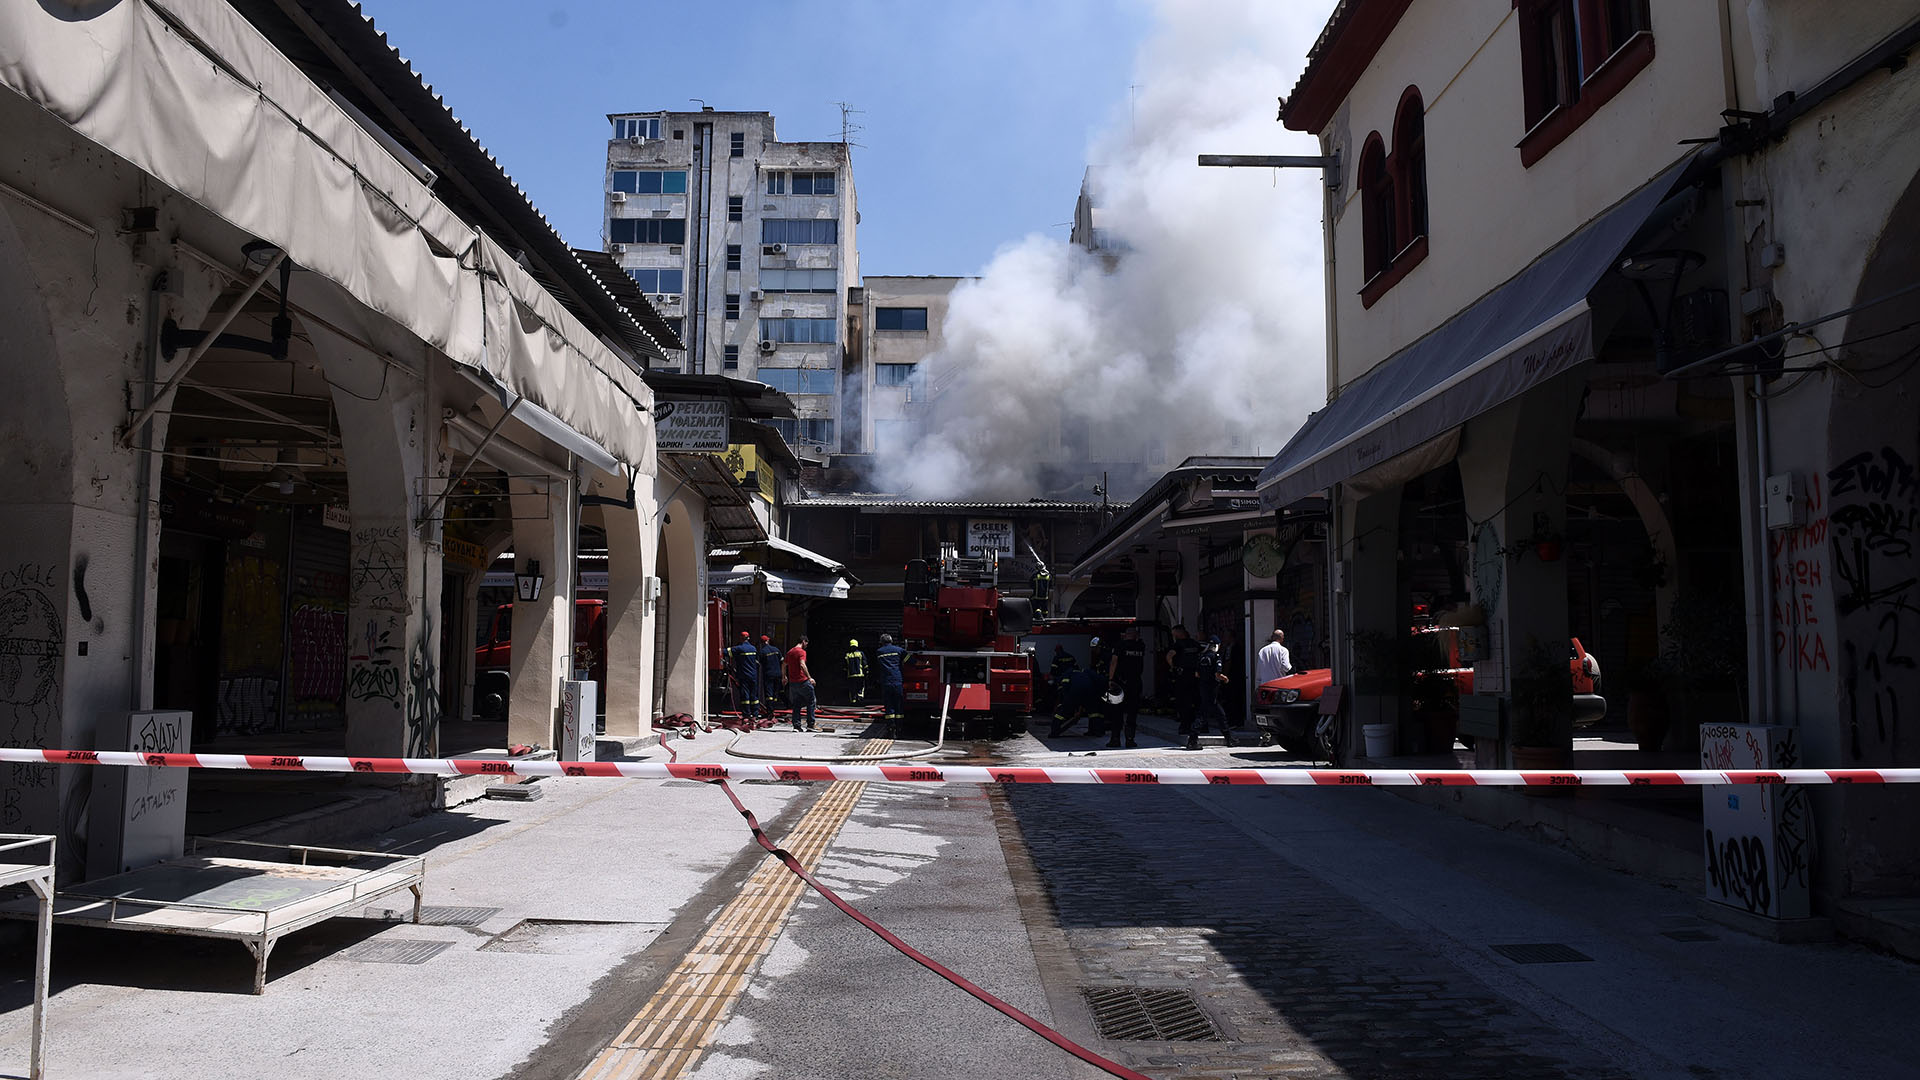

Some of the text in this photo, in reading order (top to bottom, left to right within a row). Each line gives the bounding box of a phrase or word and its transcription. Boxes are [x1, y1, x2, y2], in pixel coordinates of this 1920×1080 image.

[677, 403, 725, 414] ΡΕΤΑΛΙΑ
[670, 416, 724, 427] ΥΦΑΣΜΑΤΑ
[973, 523, 1008, 531] GREEK
[65, 752, 99, 761] POLICE
[271, 758, 304, 766] POLICE
[481, 762, 514, 772] POLICE
[695, 768, 728, 776] POLICE
[910, 770, 943, 780] POLICE
[1125, 774, 1158, 782] POLICE
[1339, 775, 1372, 784] POLICE
[1550, 776, 1582, 784] POLICE
[1755, 776, 1786, 784] POLICE
[131, 789, 177, 822] CATALYST
